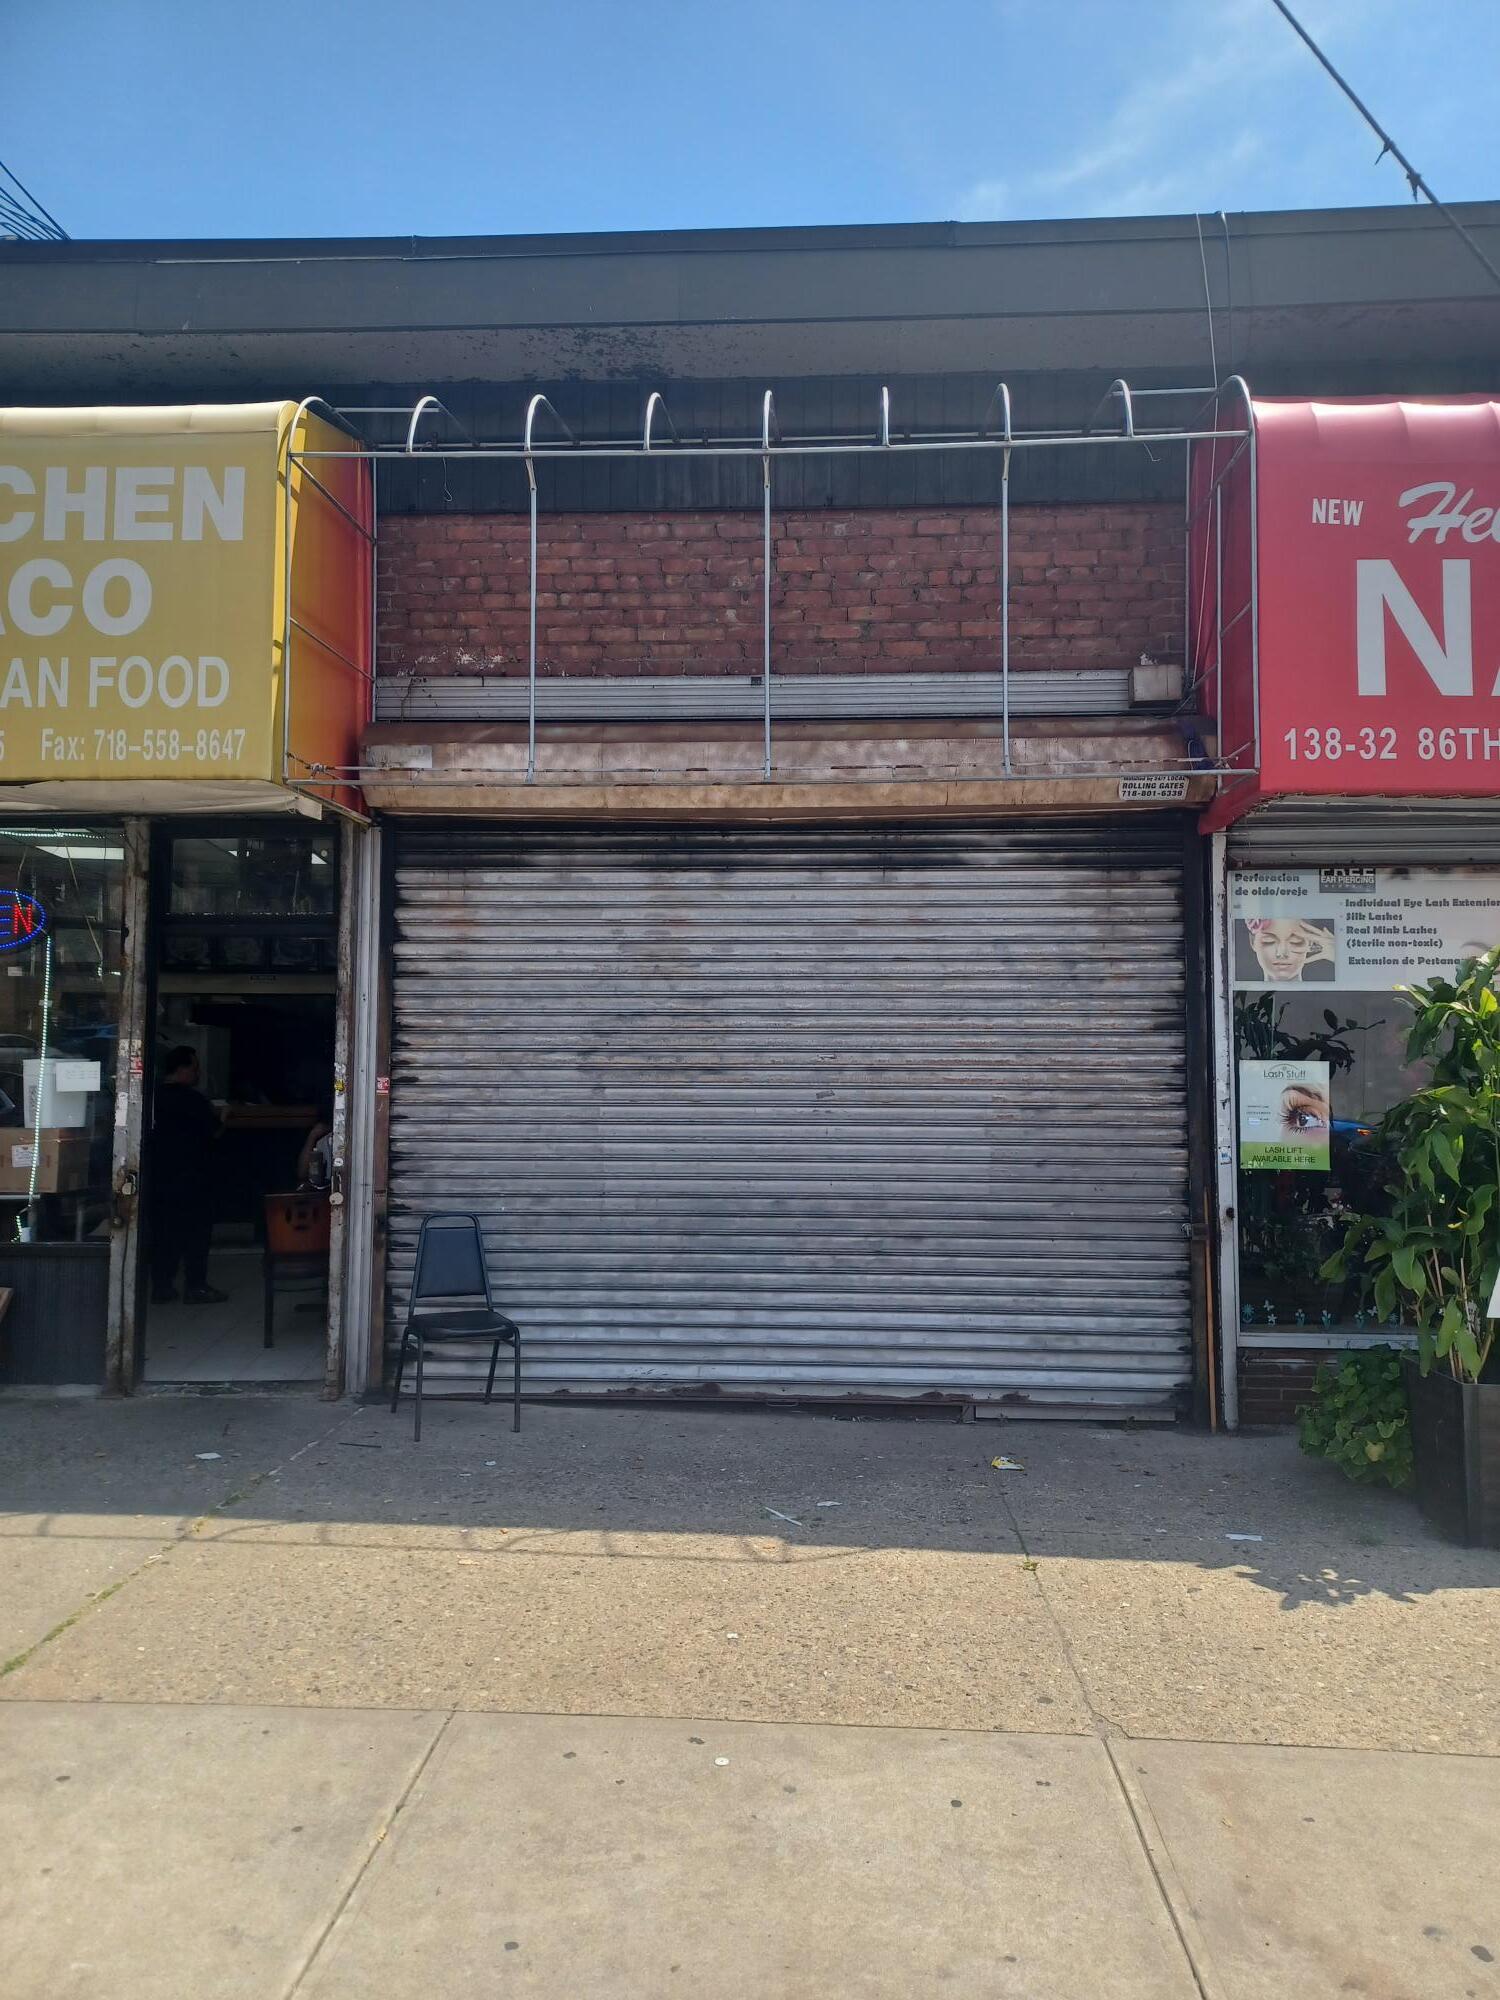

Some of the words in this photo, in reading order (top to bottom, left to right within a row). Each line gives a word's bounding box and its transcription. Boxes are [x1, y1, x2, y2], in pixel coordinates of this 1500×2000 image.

[1311, 497, 1363, 526] NEW
[0, 557, 152, 636] CO
[1356, 558, 1500, 697] N
[88, 655, 230, 708] FOOD
[41, 727, 85, 761] Fax:
[94, 728, 246, 761] 718-558-8647
[1284, 727, 1398, 760] 138-32
[1122, 782, 1156, 790] ROLLING
[1159, 782, 1185, 790] GATES
[1235, 872, 1299, 882] Perforacion
[1234, 886, 1249, 896] de
[1345, 899, 1400, 907] Individual
[1404, 899, 1422, 909] Eye
[1425, 899, 1449, 907] Lash
[1346, 912, 1366, 921] Silk
[1368, 912, 1402, 921] Lashes
[1346, 926, 1370, 934] Real
[1403, 926, 1437, 934] Lashes
[1388, 939, 1443, 948] non-toxic)
[1348, 956, 1399, 965] Extension
[1402, 956, 1414, 965] de
[1417, 956, 1467, 965] Pestana
[1263, 1070, 1284, 1078] Lash
[1286, 1070, 1306, 1078] Stuff
[1252, 1155, 1292, 1163] AVAILABLE
